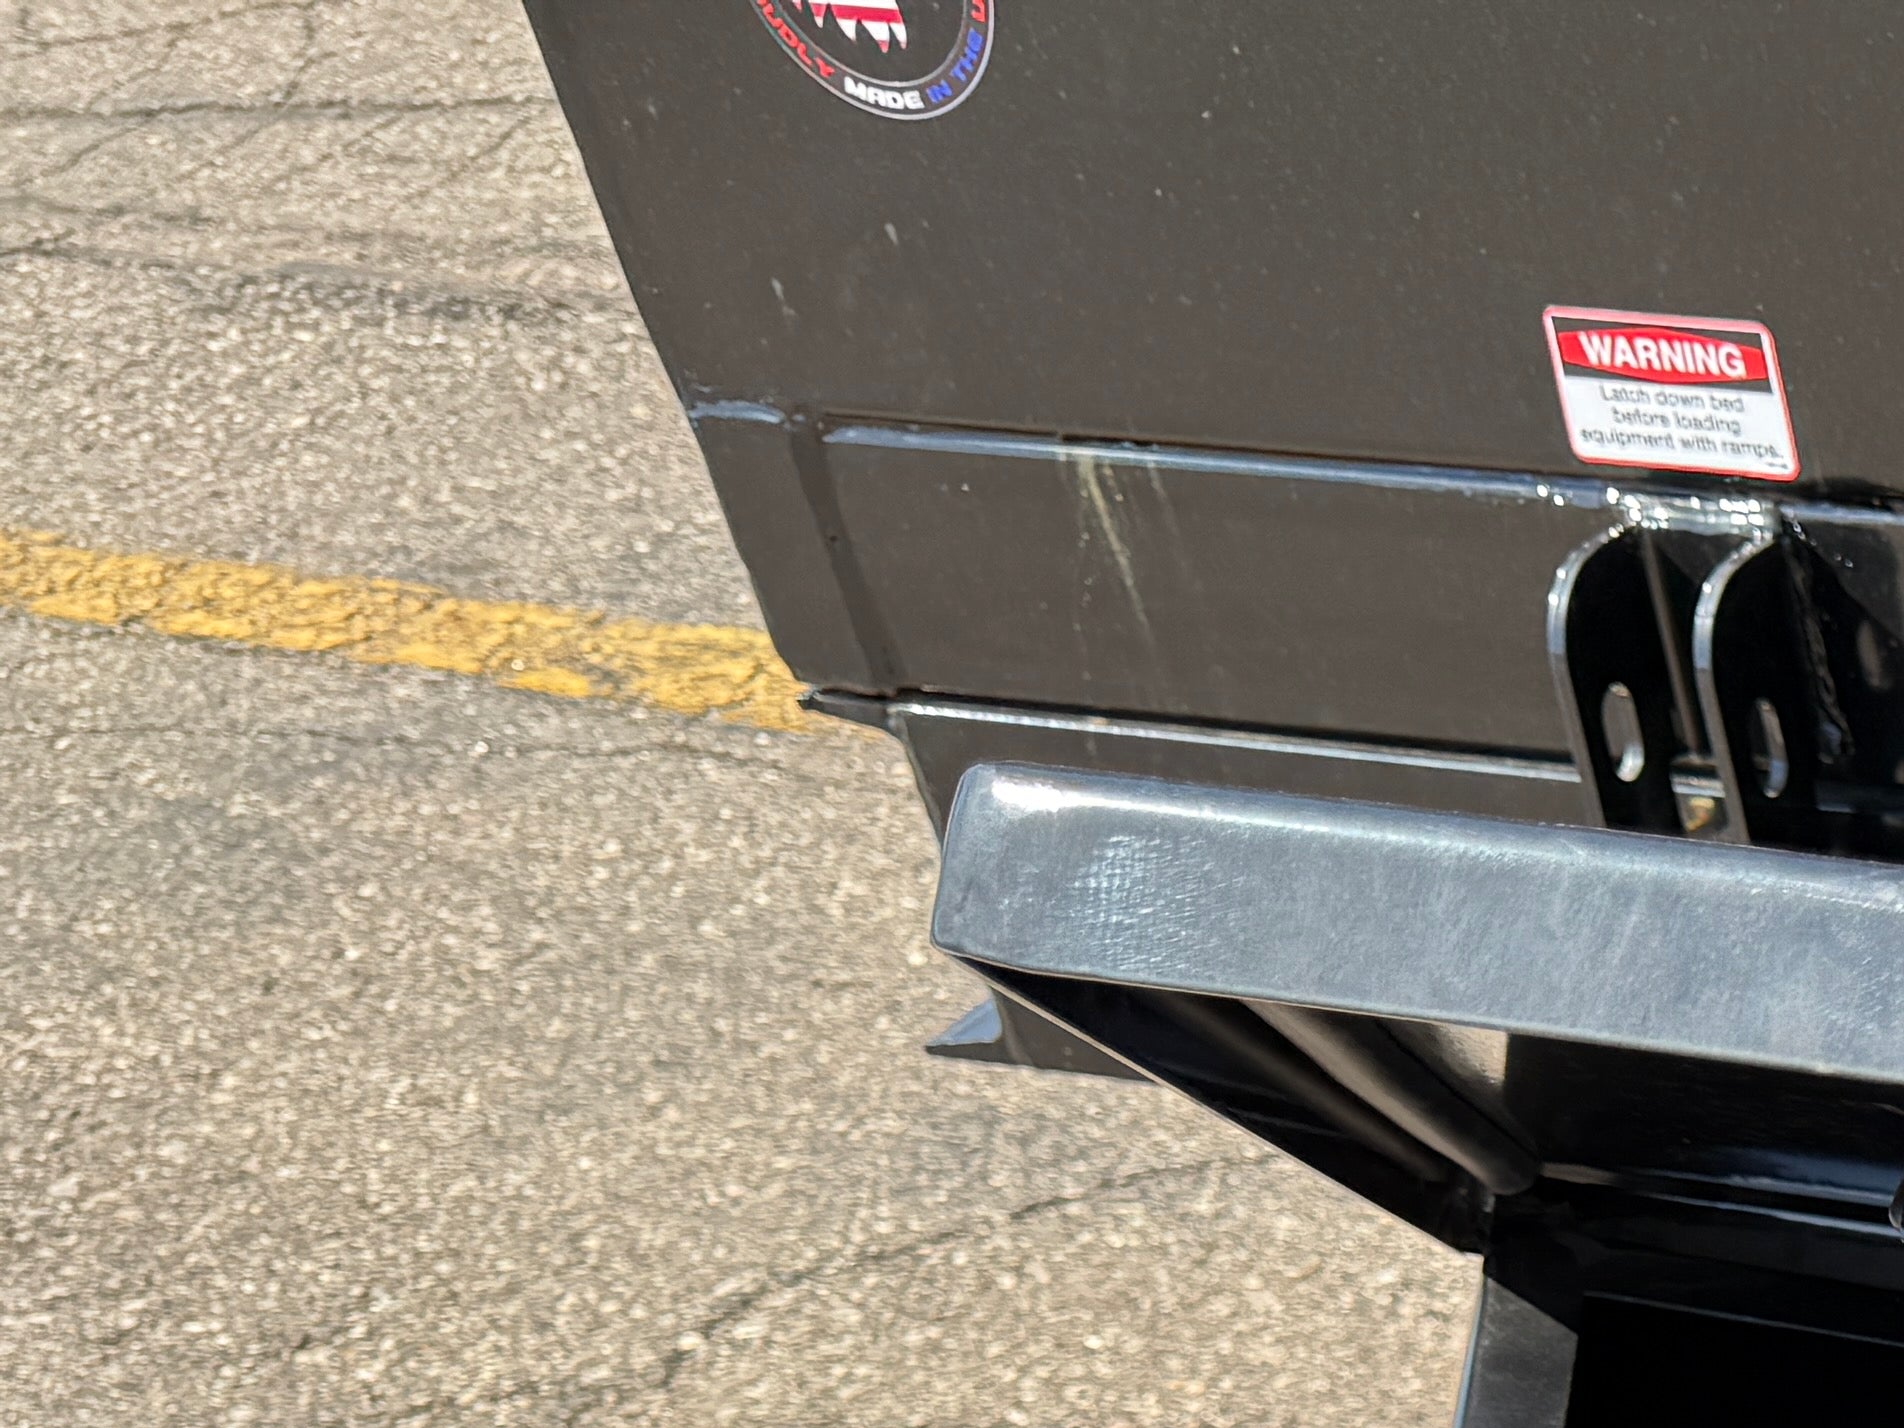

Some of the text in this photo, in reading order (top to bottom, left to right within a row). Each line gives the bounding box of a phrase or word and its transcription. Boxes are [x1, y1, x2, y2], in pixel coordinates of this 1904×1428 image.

[844, 76, 926, 110] MADE
[926, 79, 953, 104] IN
[1578, 331, 1747, 379] WARNING
[1599, 385, 1745, 413] Latch down bed
[1611, 406, 1742, 437] before loading
[1581, 428, 1784, 459] equipment with ramps.
